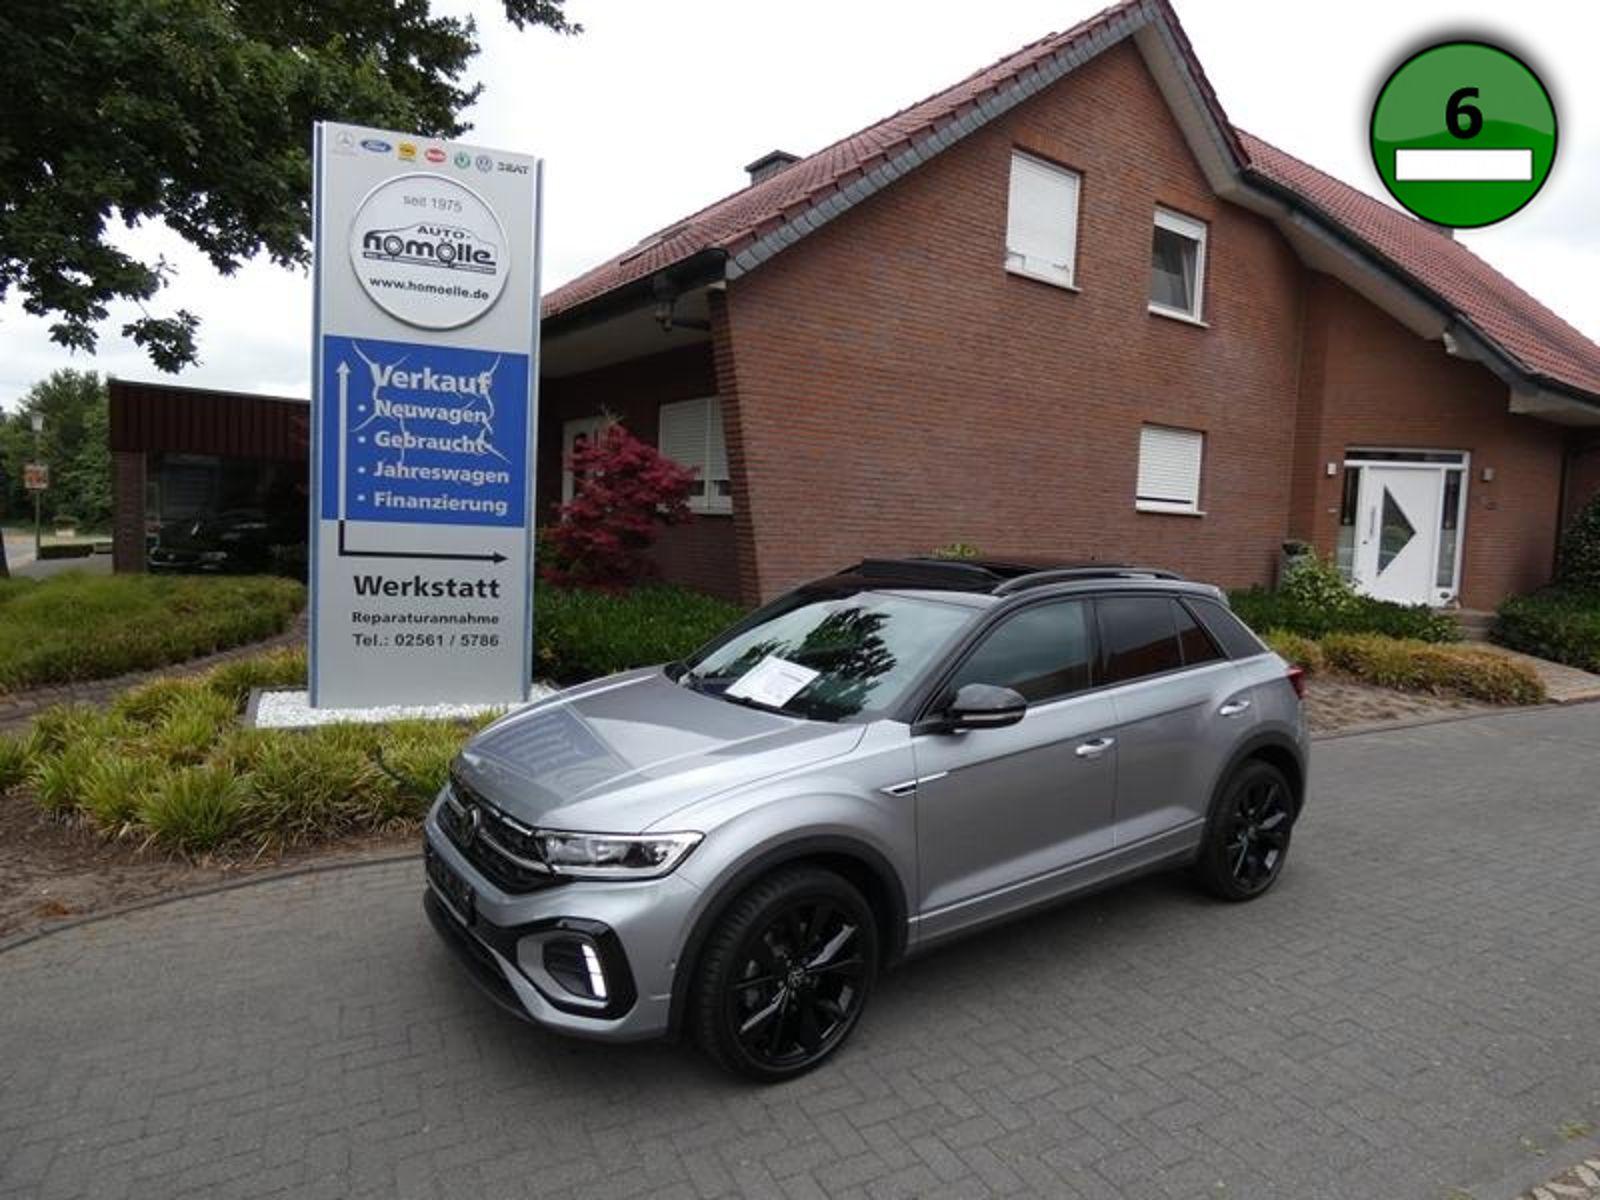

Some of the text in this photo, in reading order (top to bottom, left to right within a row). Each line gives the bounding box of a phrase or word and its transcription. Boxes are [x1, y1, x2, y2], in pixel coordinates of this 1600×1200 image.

[431, 197, 462, 212] 1975
[369, 278, 489, 300] www.homoelle.de
[370, 363, 492, 395] Verkauf
[374, 399, 488, 425] Neuwagen
[374, 430, 487, 454] Gebraucht
[373, 461, 510, 486] Jahreswagen
[373, 491, 508, 517] Finanzierung
[353, 575, 501, 599] Werkstatt
[352, 611, 499, 625] Reparaturannahme
[352, 633, 389, 647] Tel.:
[395, 633, 443, 647] 02561
[461, 633, 499, 648] 5786
